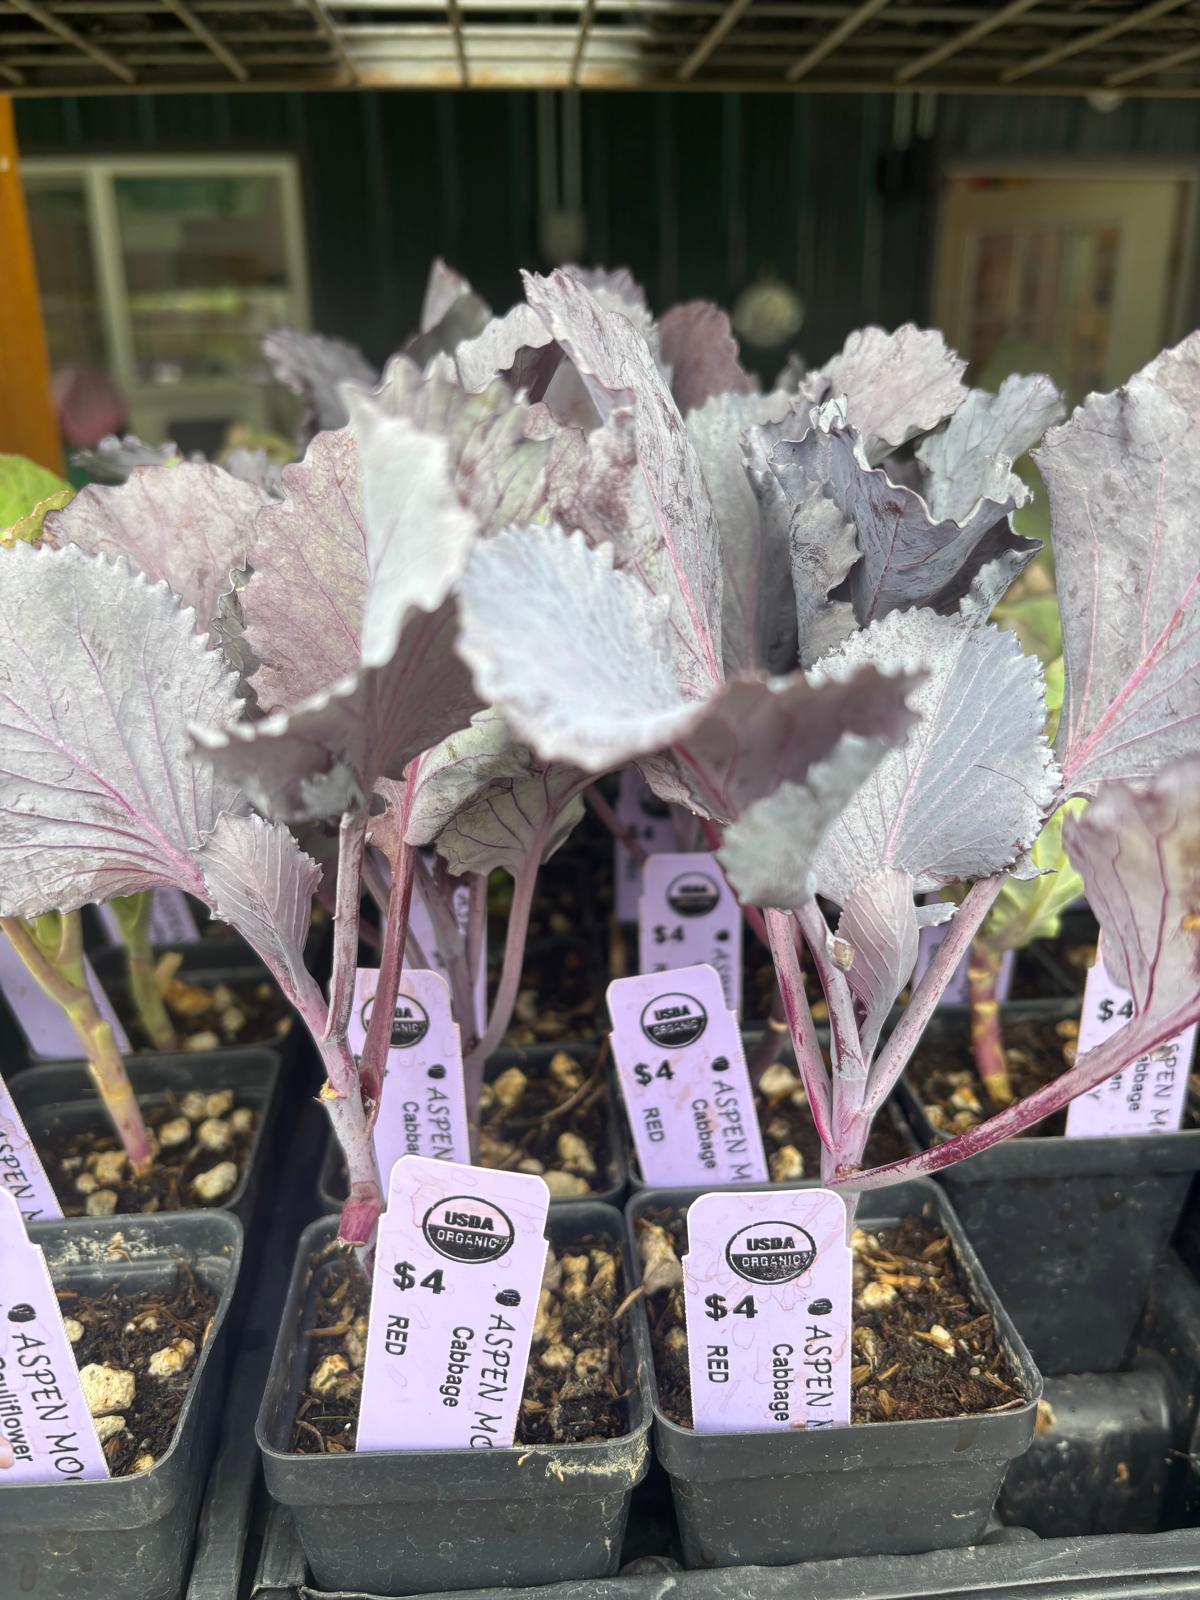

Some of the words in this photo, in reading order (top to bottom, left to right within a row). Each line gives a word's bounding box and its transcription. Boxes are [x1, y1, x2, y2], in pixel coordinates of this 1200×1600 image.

[654, 1005, 691, 1021] USDA
[1097, 998, 1133, 1023] $4
[633, 1060, 675, 1087] $4
[1127, 1056, 1149, 1112] abbage
[426, 1086, 455, 1161] ASPEN
[642, 1107, 665, 1143] RED
[691, 1099, 718, 1169] Cabbage
[713, 1081, 747, 1154] ASPEN
[436, 1229, 498, 1249] ORGANIC
[443, 1210, 495, 1232] USDA
[741, 1254, 801, 1268] ORGANIC
[746, 1236, 796, 1252] USDA
[392, 1260, 446, 1295] $4
[704, 1293, 759, 1321] $4
[384, 1314, 410, 1357] RED
[11, 1332, 69, 1421] ASPEN
[438, 1325, 475, 1408] Cabbage
[477, 1313, 517, 1403] ASPEN
[706, 1344, 730, 1384] RED
[803, 1324, 835, 1408] ASPEN
[768, 1343, 794, 1422] Cabbage
